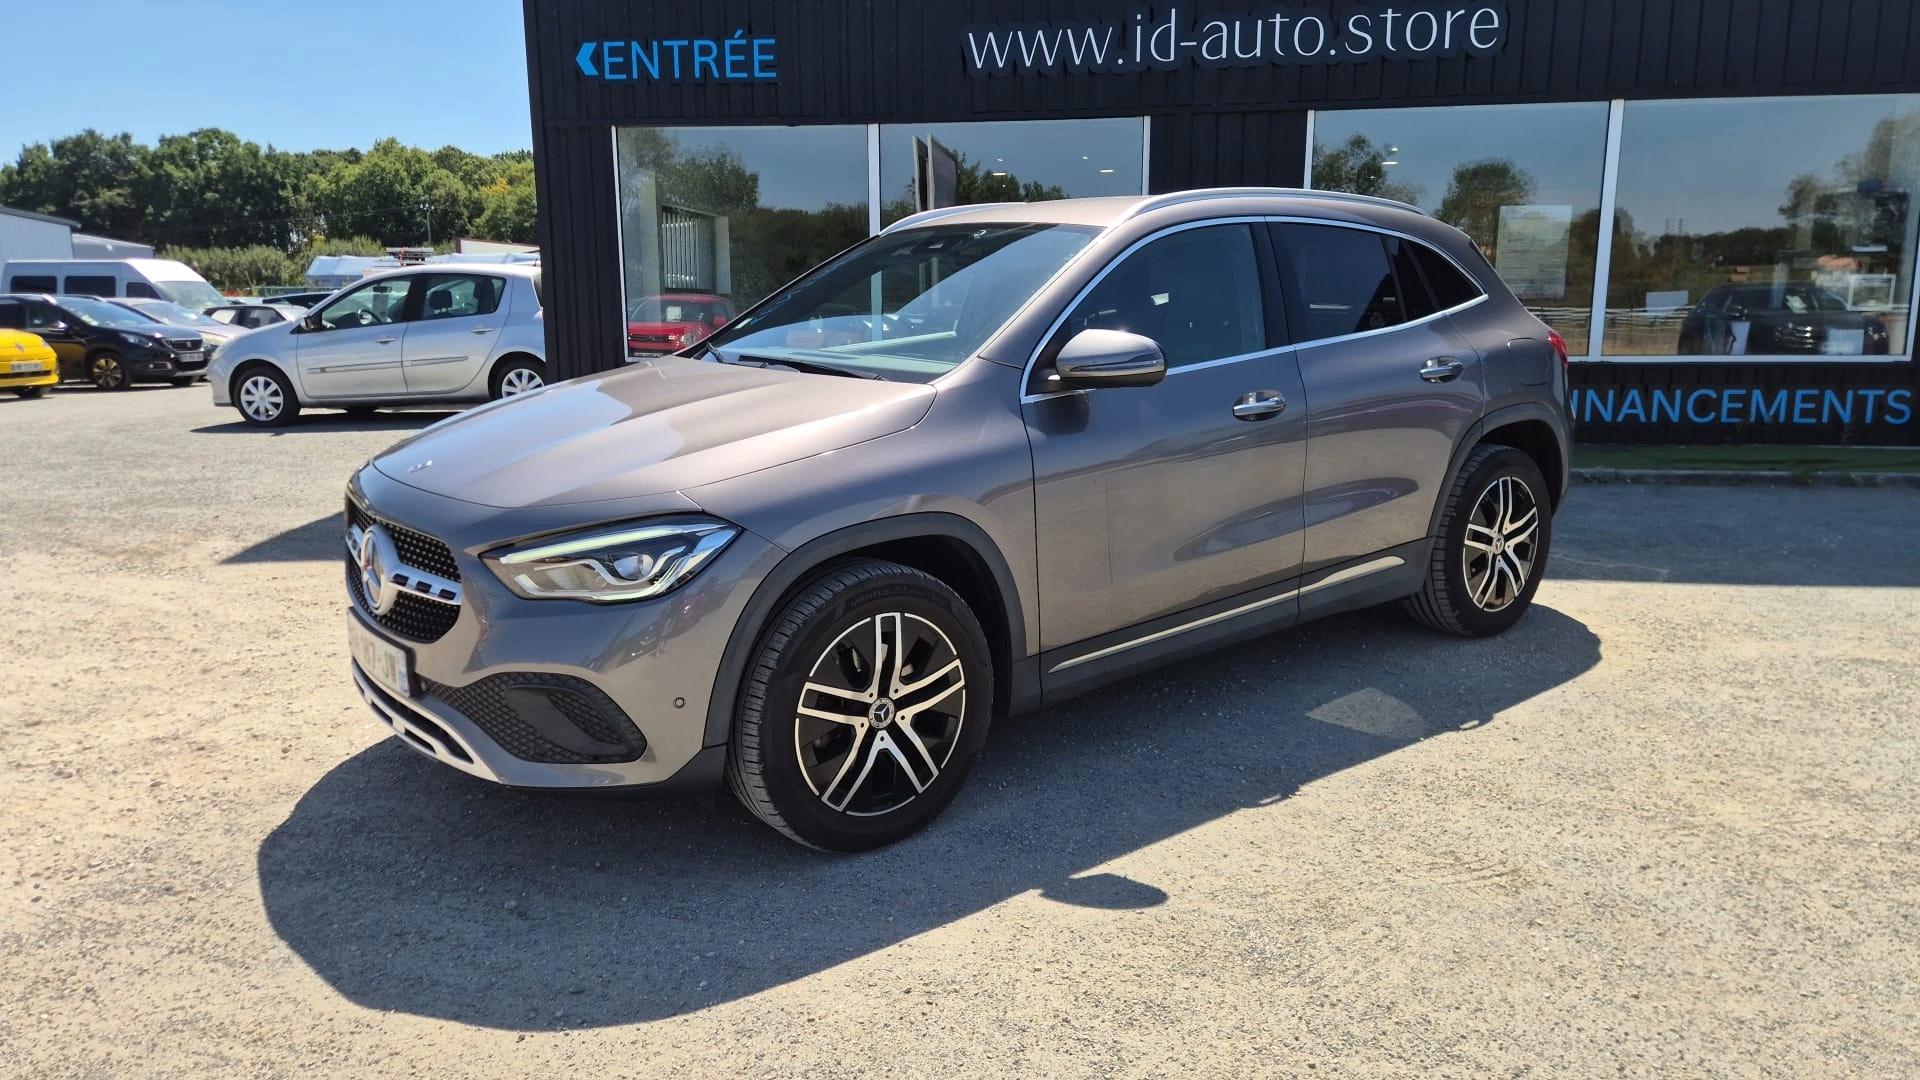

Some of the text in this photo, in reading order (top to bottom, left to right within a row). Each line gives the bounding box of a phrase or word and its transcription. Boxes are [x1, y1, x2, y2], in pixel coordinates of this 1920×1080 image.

[603, 29, 778, 80] ENTRÉE
[968, 6, 1500, 70] www.id-auto.store
[1572, 388, 1912, 424] INANCEMENTS
